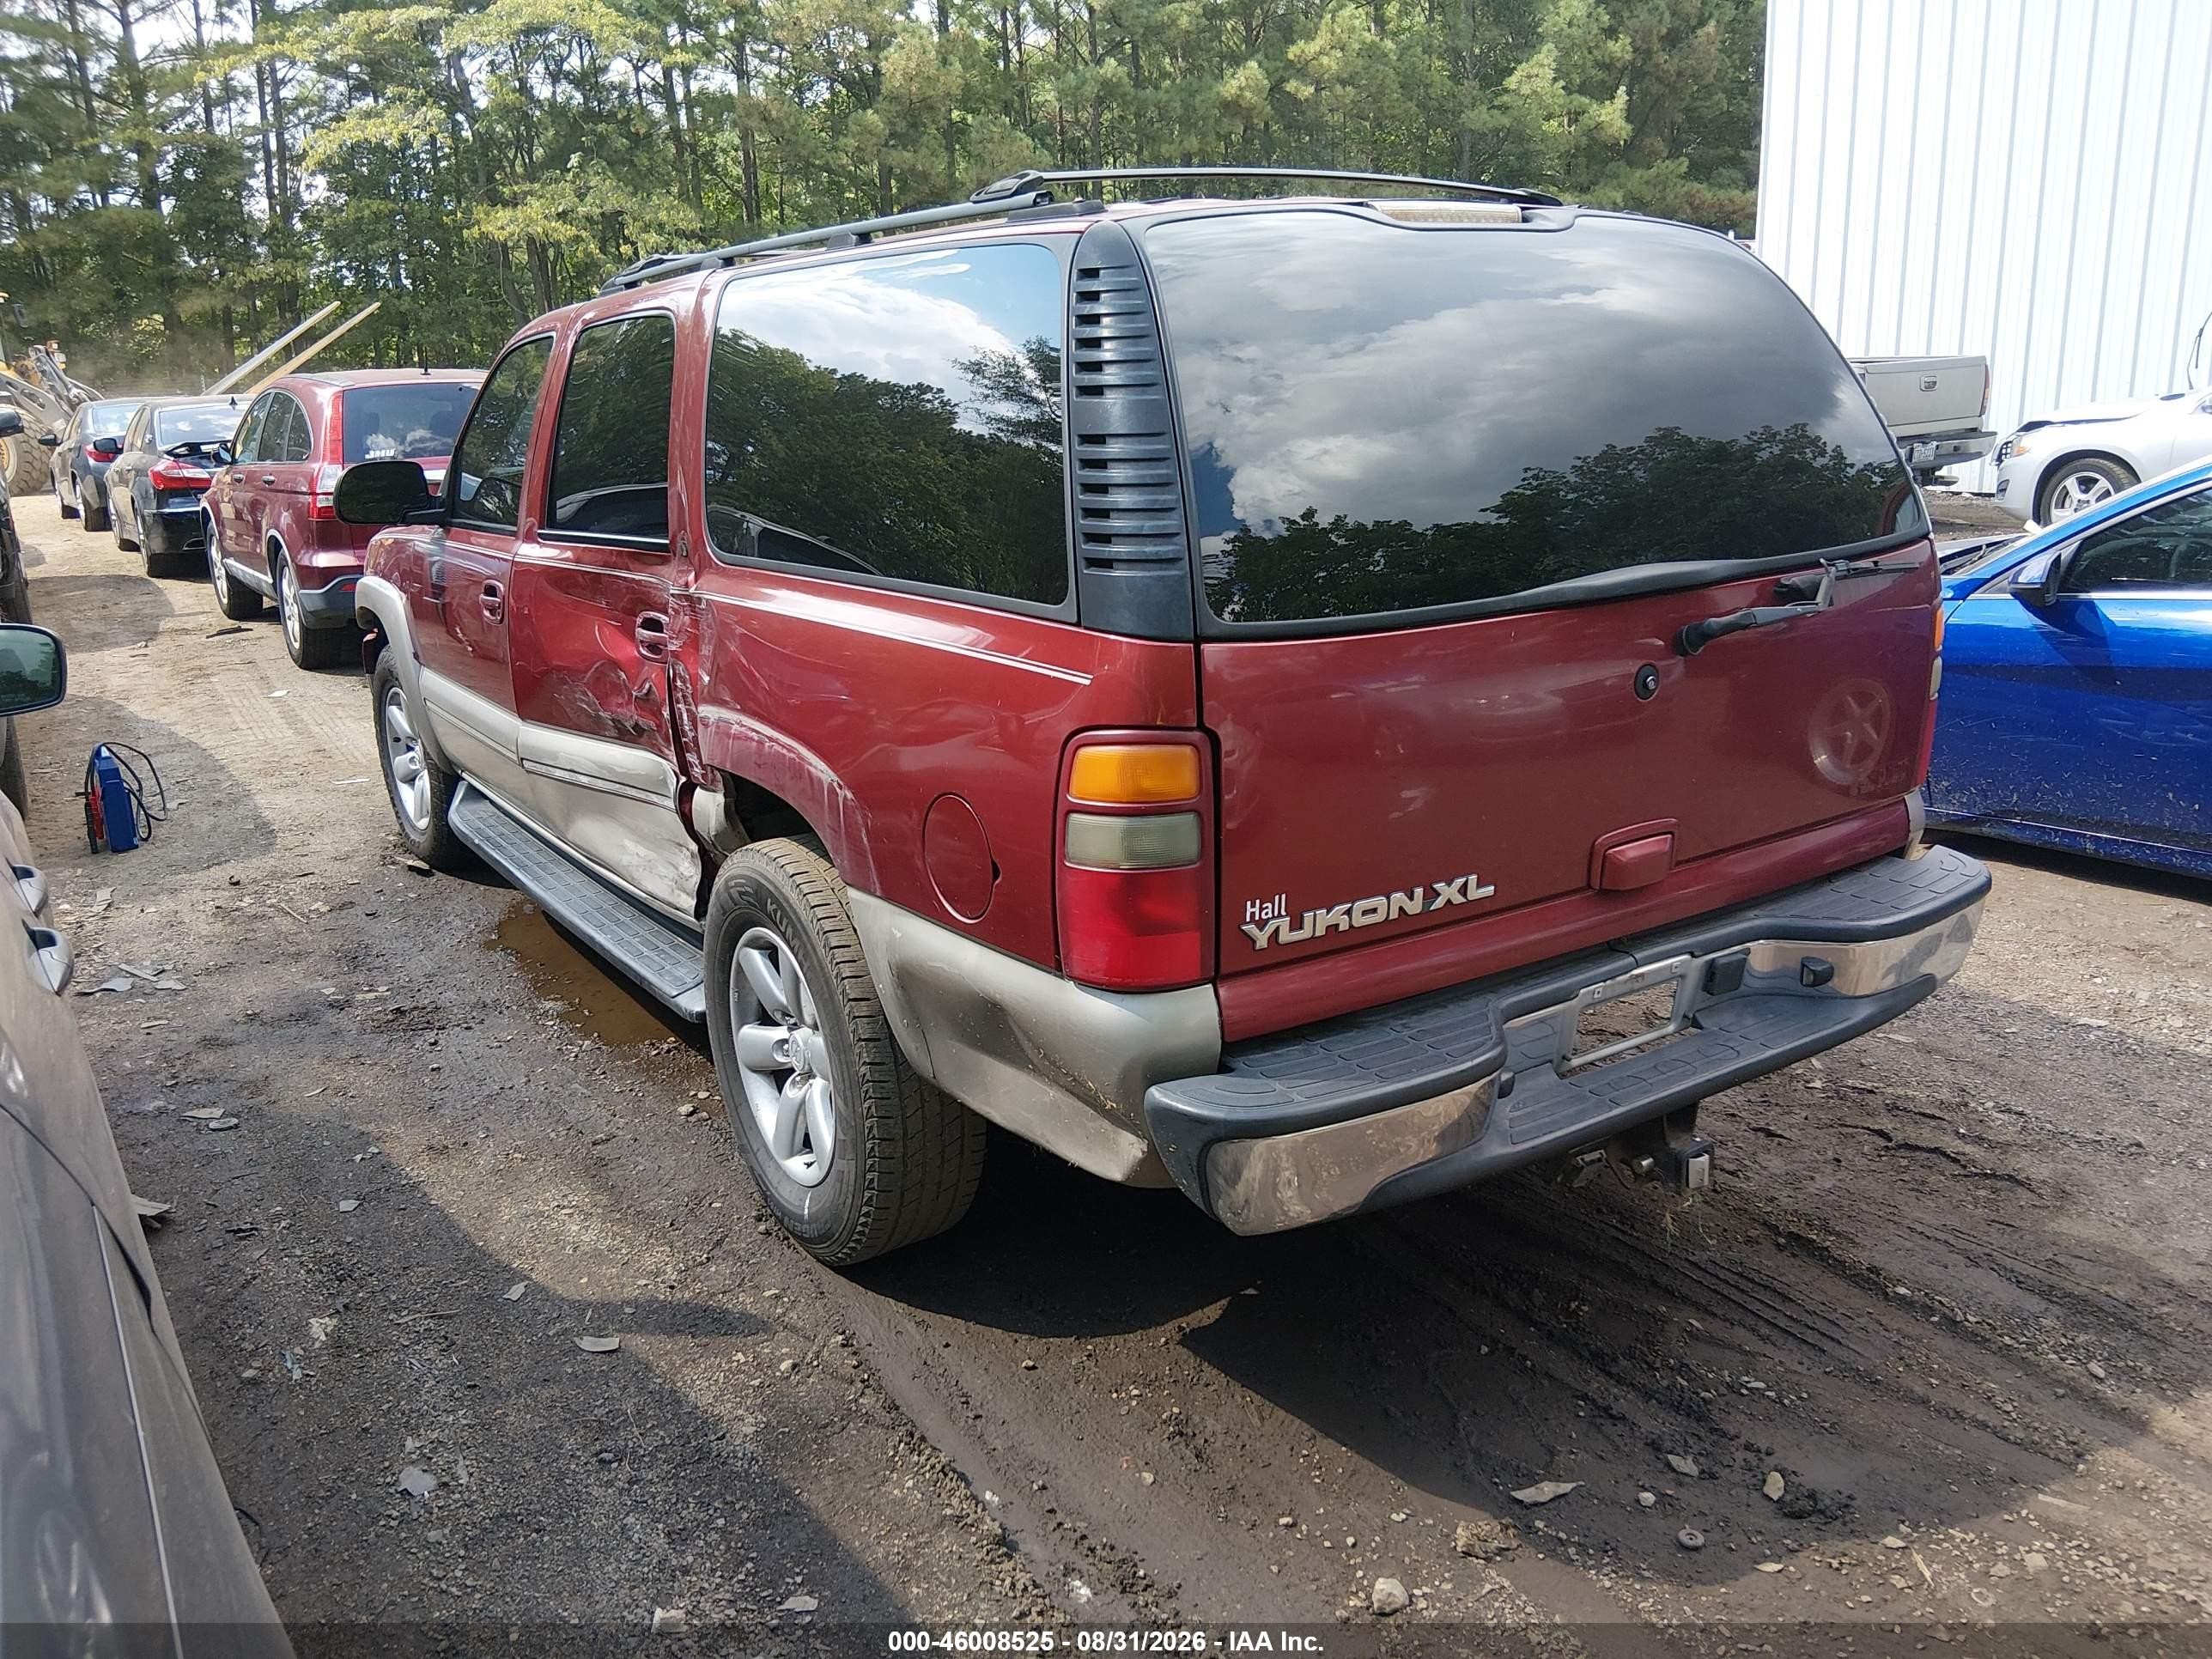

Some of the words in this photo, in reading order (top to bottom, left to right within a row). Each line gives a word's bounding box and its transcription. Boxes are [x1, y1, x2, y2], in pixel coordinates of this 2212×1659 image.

[1240, 885, 1425, 951] YUKON
[1429, 873, 1496, 912] XL
[1245, 892, 1288, 922] Hall
